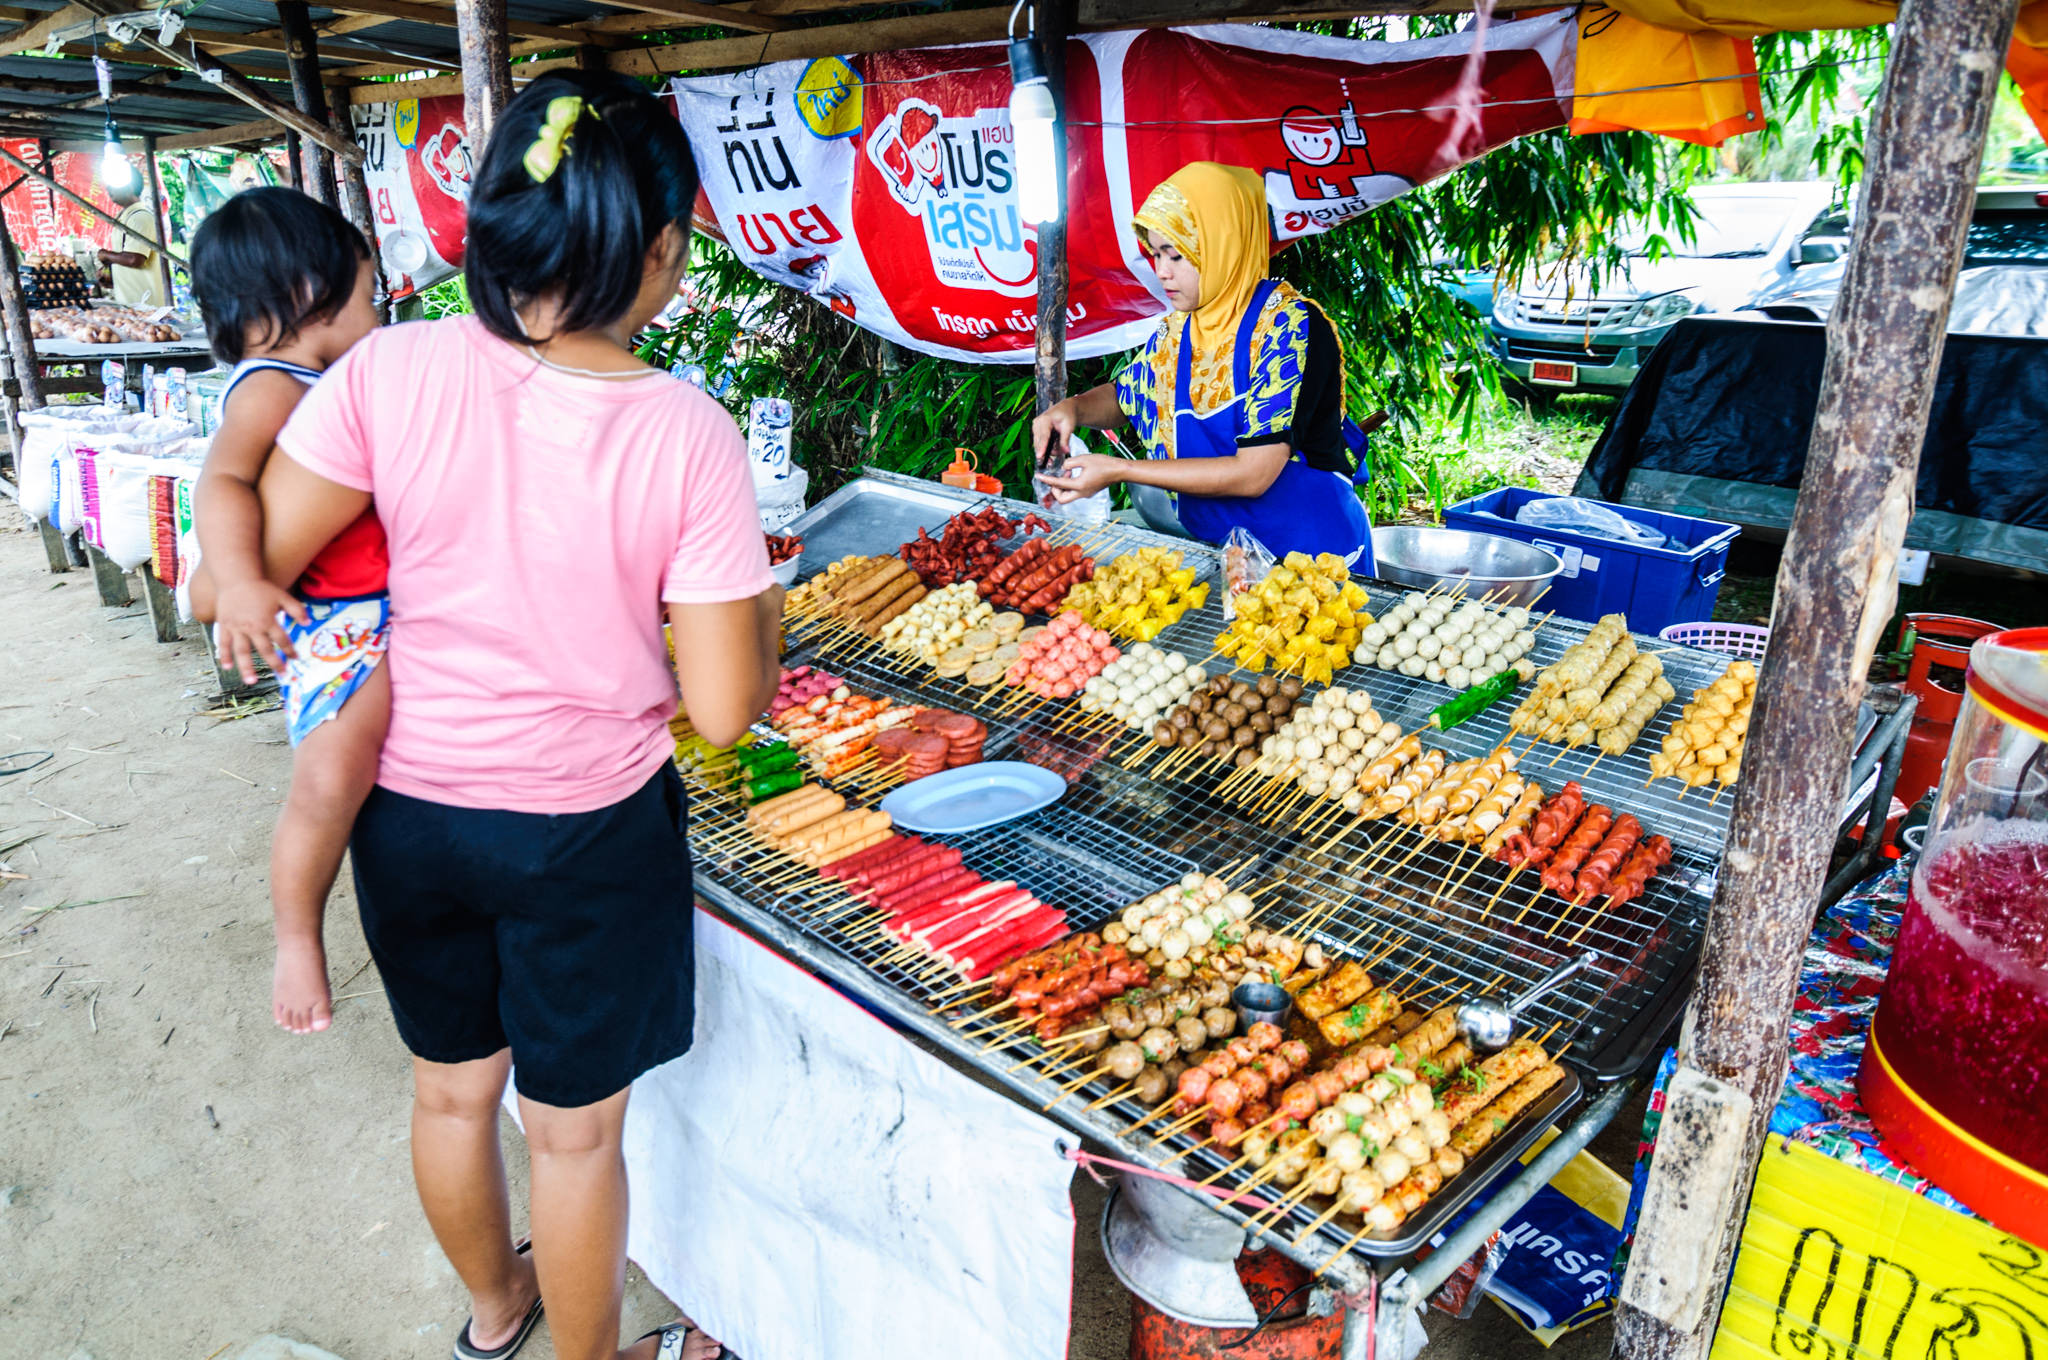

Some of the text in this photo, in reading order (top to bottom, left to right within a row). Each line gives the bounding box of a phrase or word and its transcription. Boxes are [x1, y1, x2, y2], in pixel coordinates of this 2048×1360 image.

[807, 72, 850, 121] ใหม่
[982, 124, 1013, 144] แฮป
[940, 130, 1012, 194] โปร
[737, 203, 843, 255] ขาย
[927, 192, 1021, 252] เสริม
[931, 306, 998, 339] โทรถูก
[762, 442, 785, 467] 20
